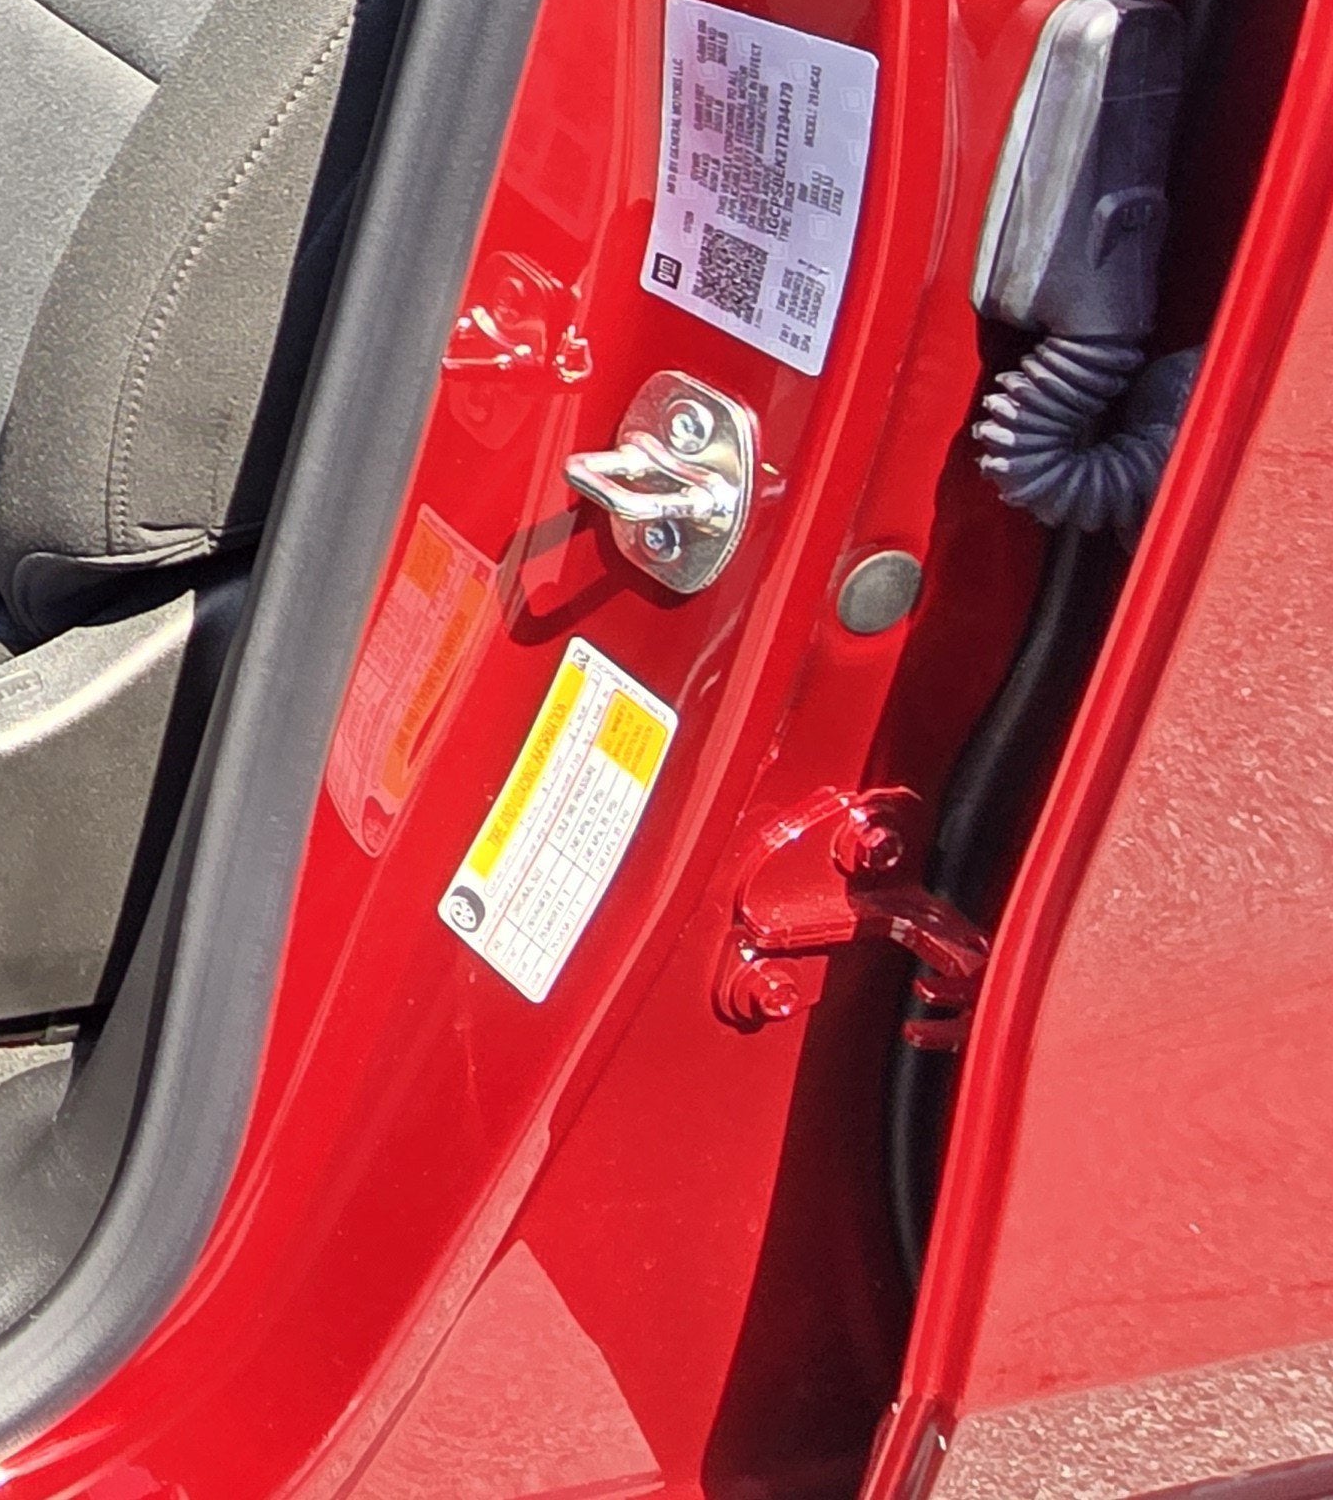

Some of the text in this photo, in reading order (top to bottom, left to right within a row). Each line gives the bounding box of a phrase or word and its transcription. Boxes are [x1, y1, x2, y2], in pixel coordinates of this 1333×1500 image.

[671, 55, 684, 77] LLC
[746, 42, 763, 80] EFFECT
[671, 75, 682, 116] MOTORS
[667, 115, 682, 160] GENERAL
